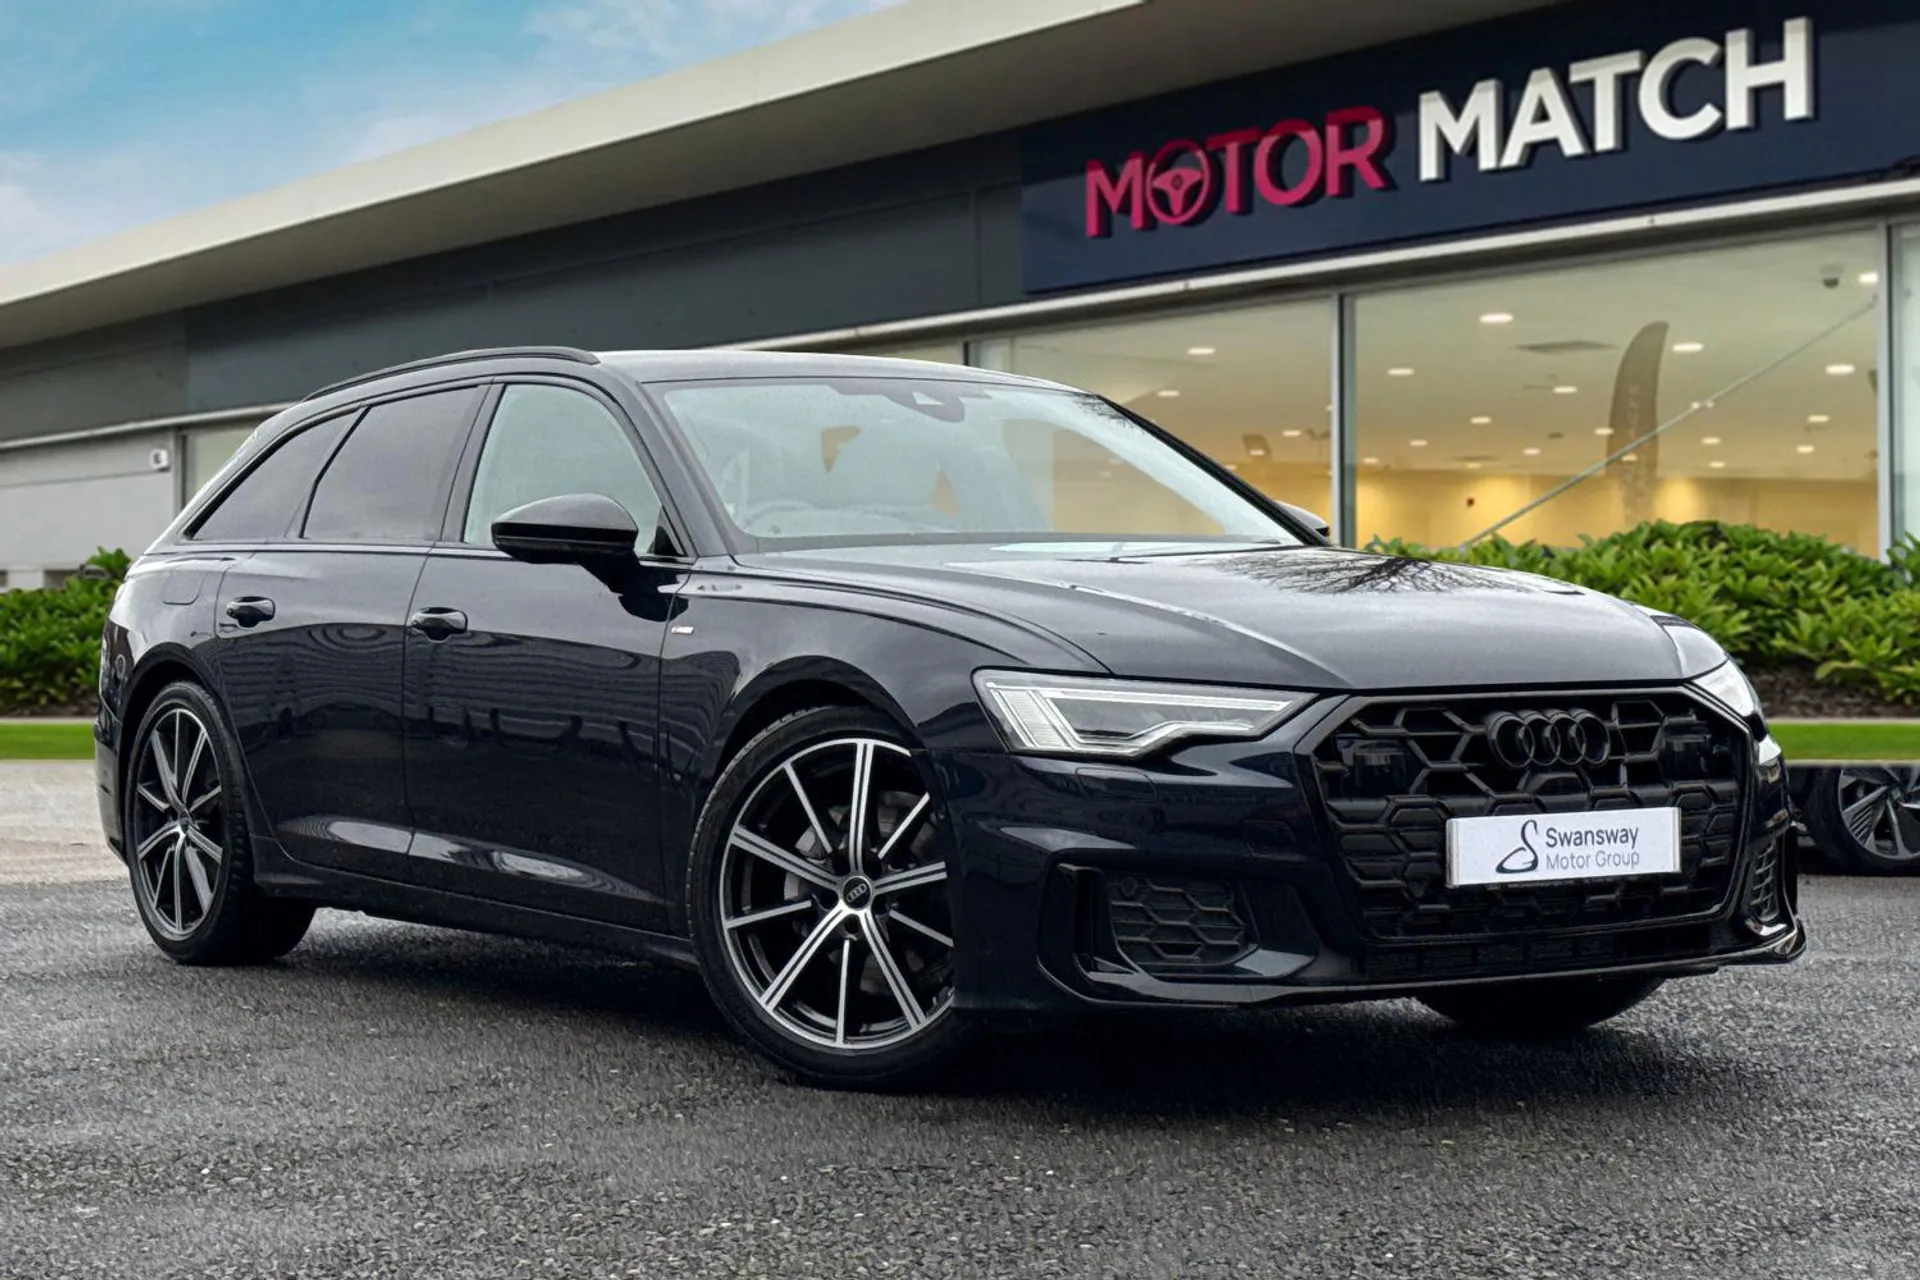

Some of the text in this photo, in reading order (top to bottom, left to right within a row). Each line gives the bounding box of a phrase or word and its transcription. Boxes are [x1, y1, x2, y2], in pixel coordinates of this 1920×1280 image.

[1085, 16, 1811, 237] MOTOR MATCH
[1545, 826, 1639, 850] Swansway
[1546, 850, 1640, 870] Motor Group
